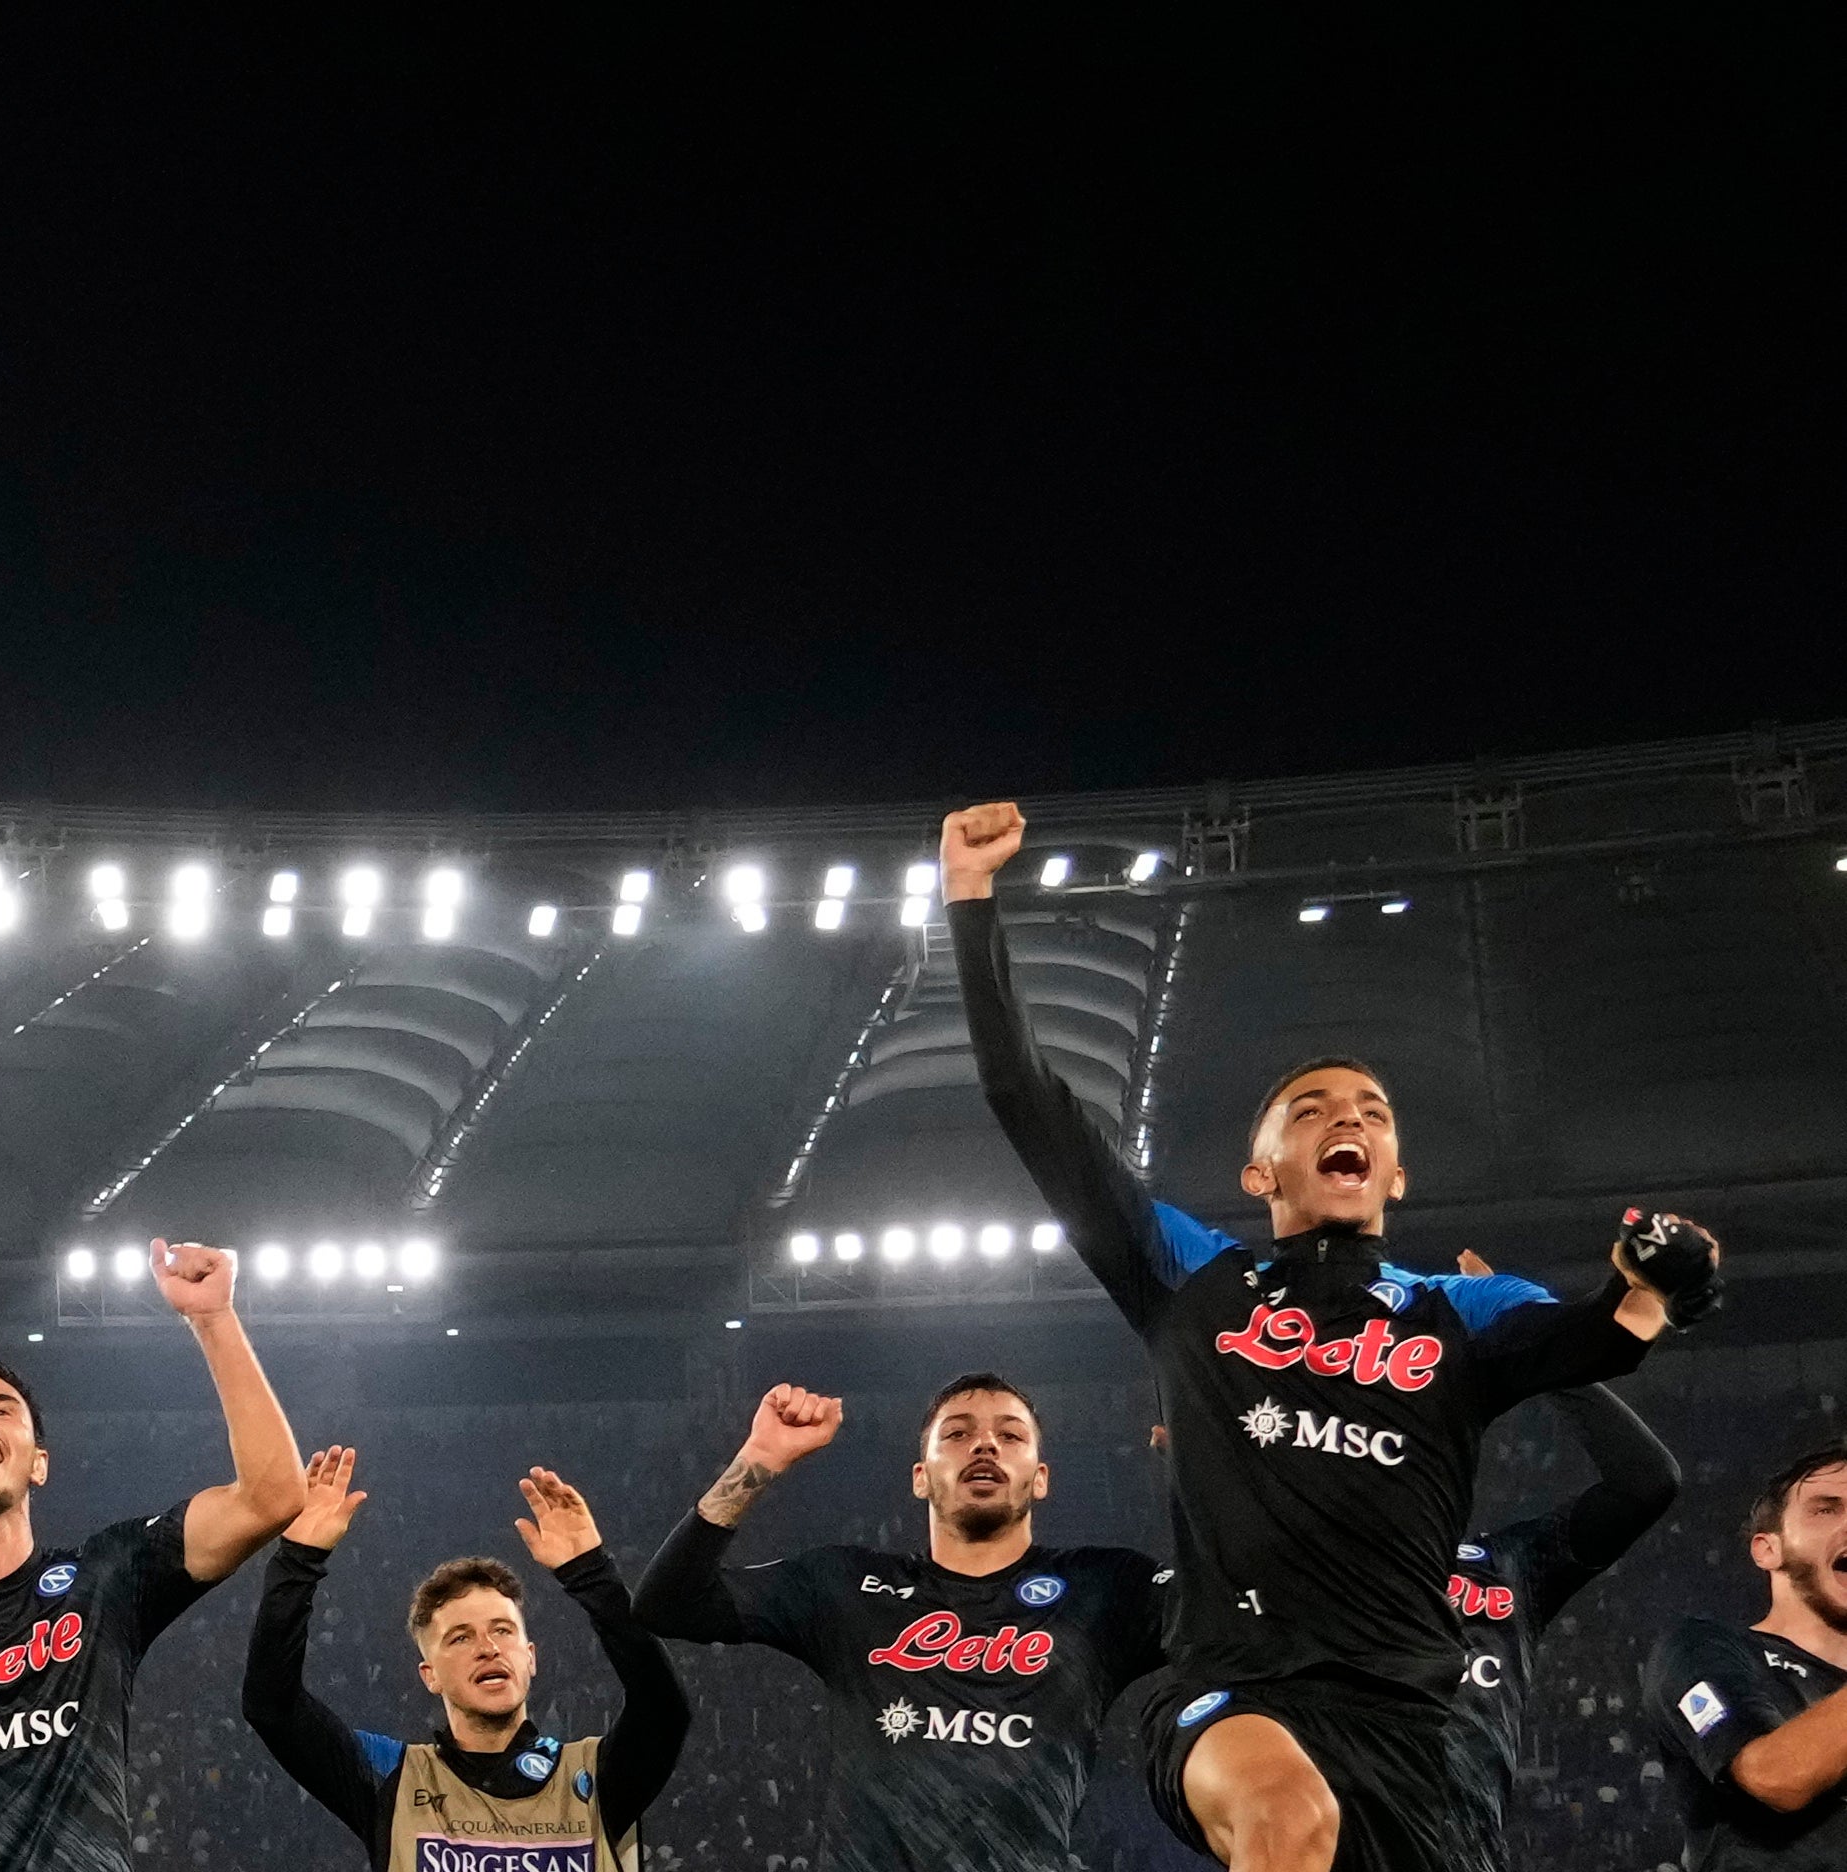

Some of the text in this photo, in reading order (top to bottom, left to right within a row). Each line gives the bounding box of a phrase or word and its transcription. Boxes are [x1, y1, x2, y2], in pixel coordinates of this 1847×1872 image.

[1216, 1304, 1443, 1392] Lete
[1292, 1410, 1405, 1466] MSC
[1447, 1574, 1514, 1619] ete
[869, 1610, 1053, 1675] Lete
[923, 1706, 1034, 1748] MSC
